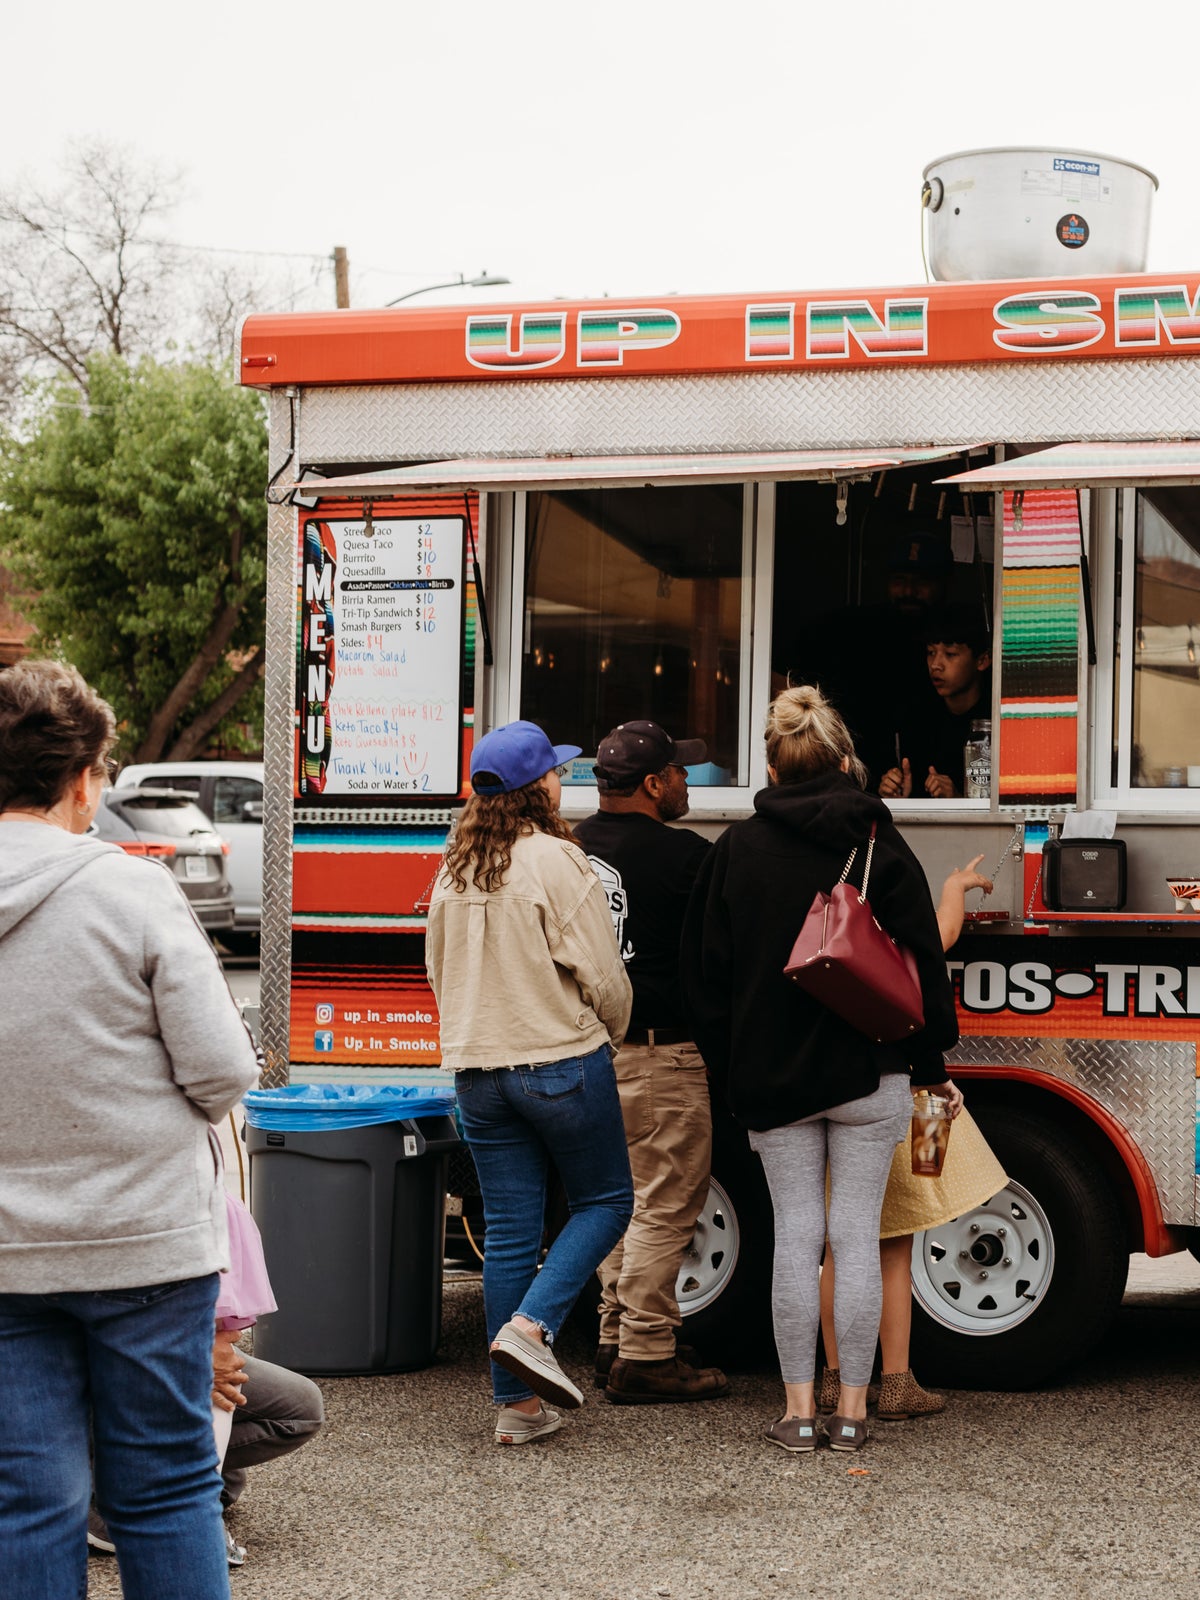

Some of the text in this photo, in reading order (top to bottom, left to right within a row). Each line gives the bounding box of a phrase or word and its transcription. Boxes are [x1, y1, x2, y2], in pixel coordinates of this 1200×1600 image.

[464, 308, 682, 371] UP
[745, 298, 929, 361] IN
[343, 526, 368, 536] Stree
[372, 526, 392, 535] Taco
[343, 540, 369, 550] Quesa
[373, 539, 393, 549] Taco
[342, 567, 386, 577] Quesadilla
[342, 595, 363, 604] Birria
[367, 595, 396, 604] Ramen
[341, 608, 371, 619] Tri-Tip
[374, 608, 413, 617] Sandwich
[341, 622, 368, 631] Smash
[370, 622, 402, 632] Burgers
[341, 638, 365, 647] Sides:
[306, 563, 332, 754] MENU
[380, 649, 406, 663] Salad
[358, 719, 381, 734] Taco
[331, 757, 367, 775] Thank
[348, 779, 368, 789] Soda
[383, 779, 409, 789] Water
[343, 1009, 440, 1026] up_in_smoke_
